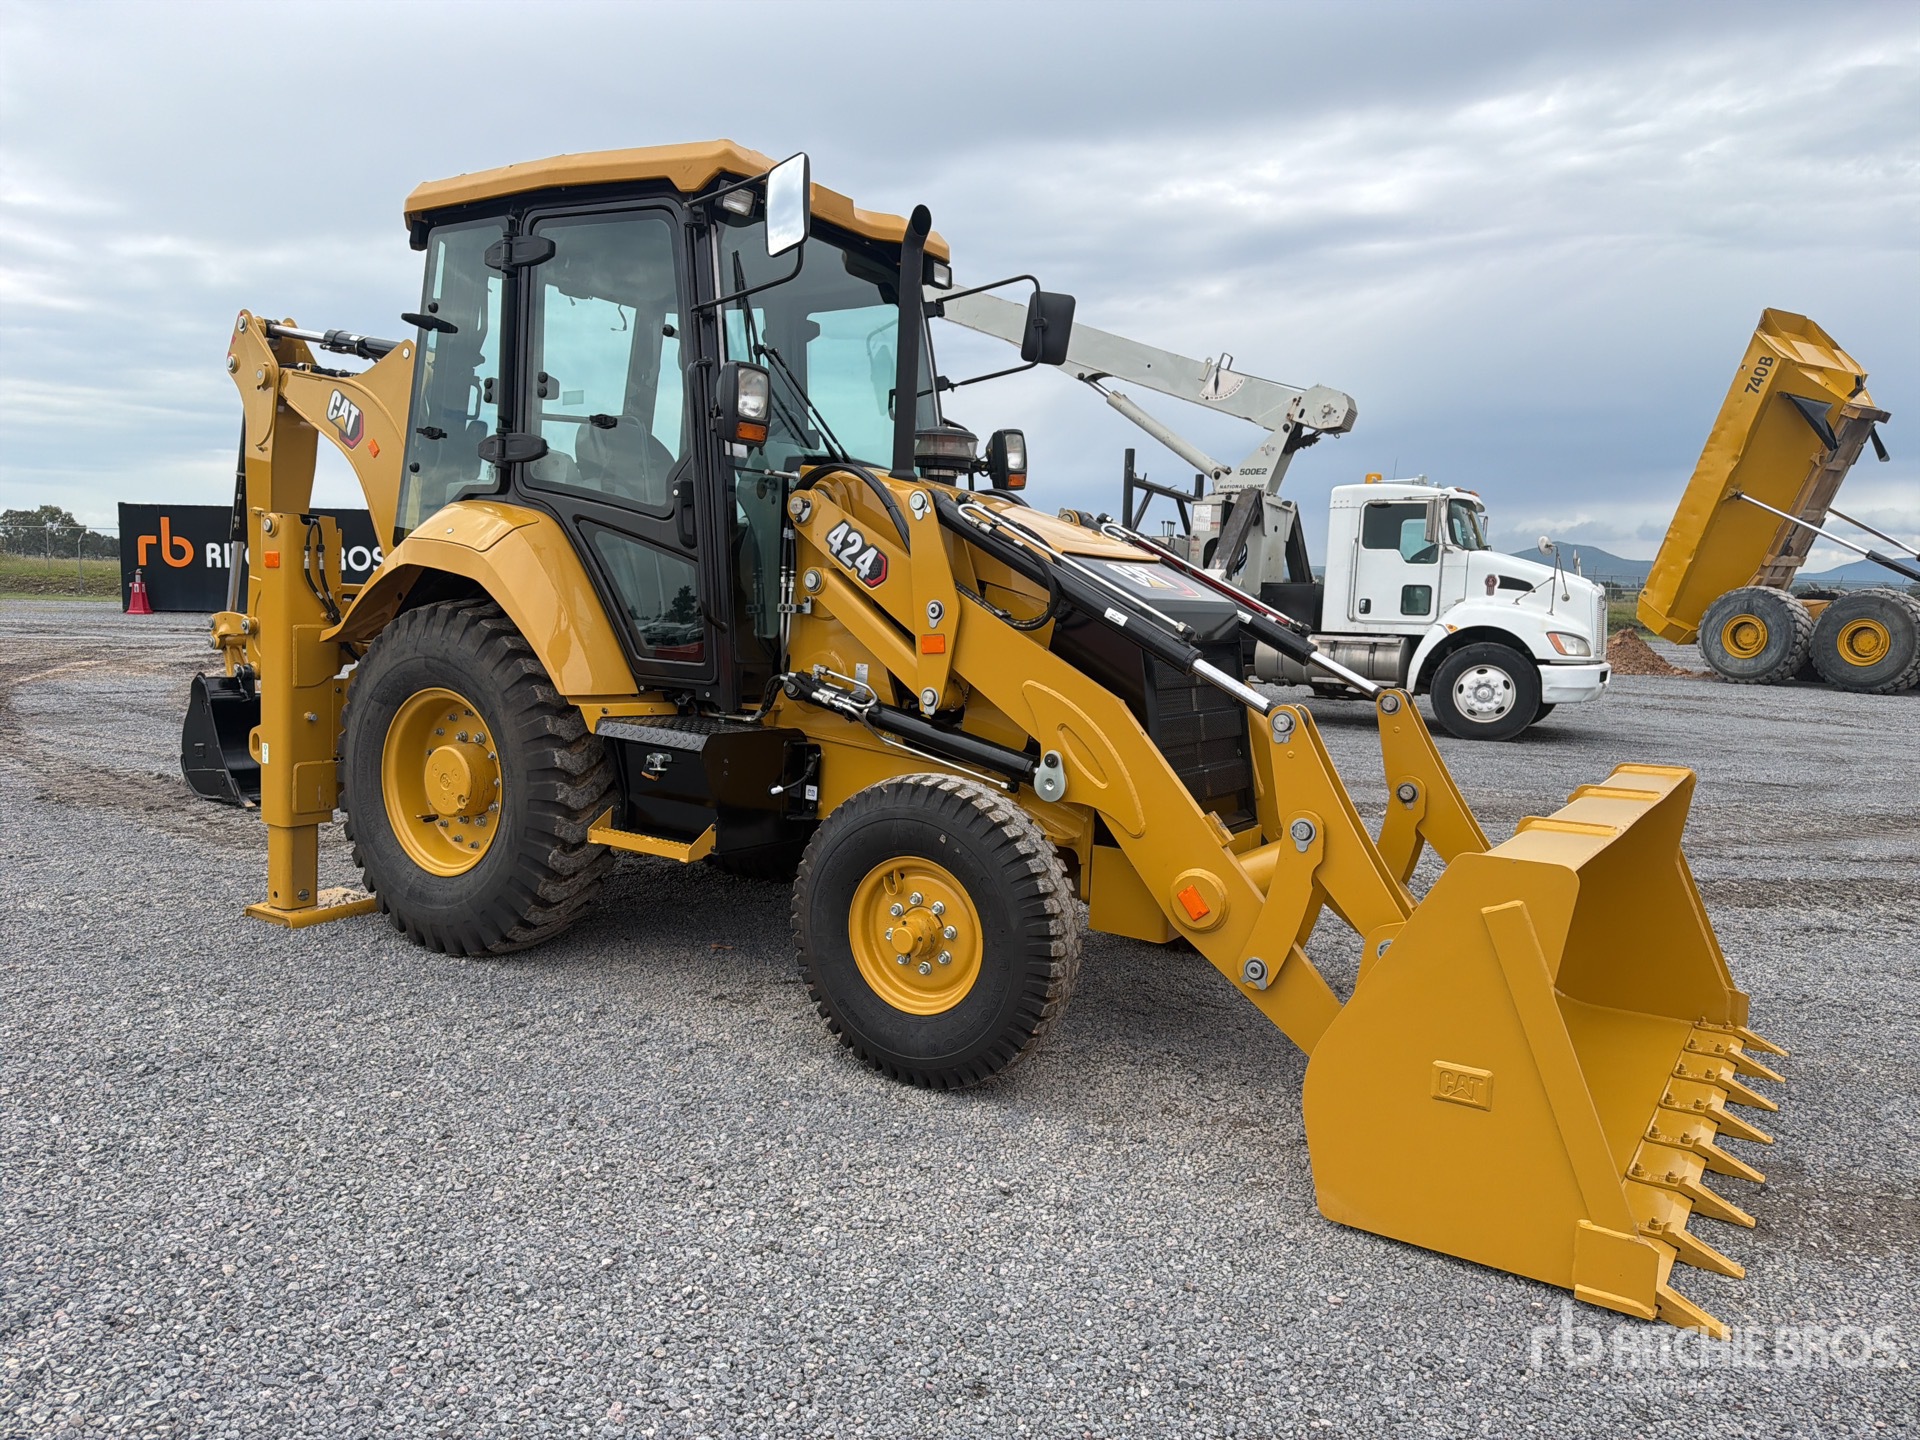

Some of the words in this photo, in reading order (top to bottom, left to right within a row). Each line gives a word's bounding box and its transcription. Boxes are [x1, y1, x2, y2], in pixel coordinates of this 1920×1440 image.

[1744, 356, 1774, 394] 740B
[327, 389, 360, 436] CAT
[1239, 467, 1268, 476] 500E2
[137, 516, 194, 568] rb
[827, 521, 878, 580] 424
[1438, 1070, 1485, 1104] CAT
